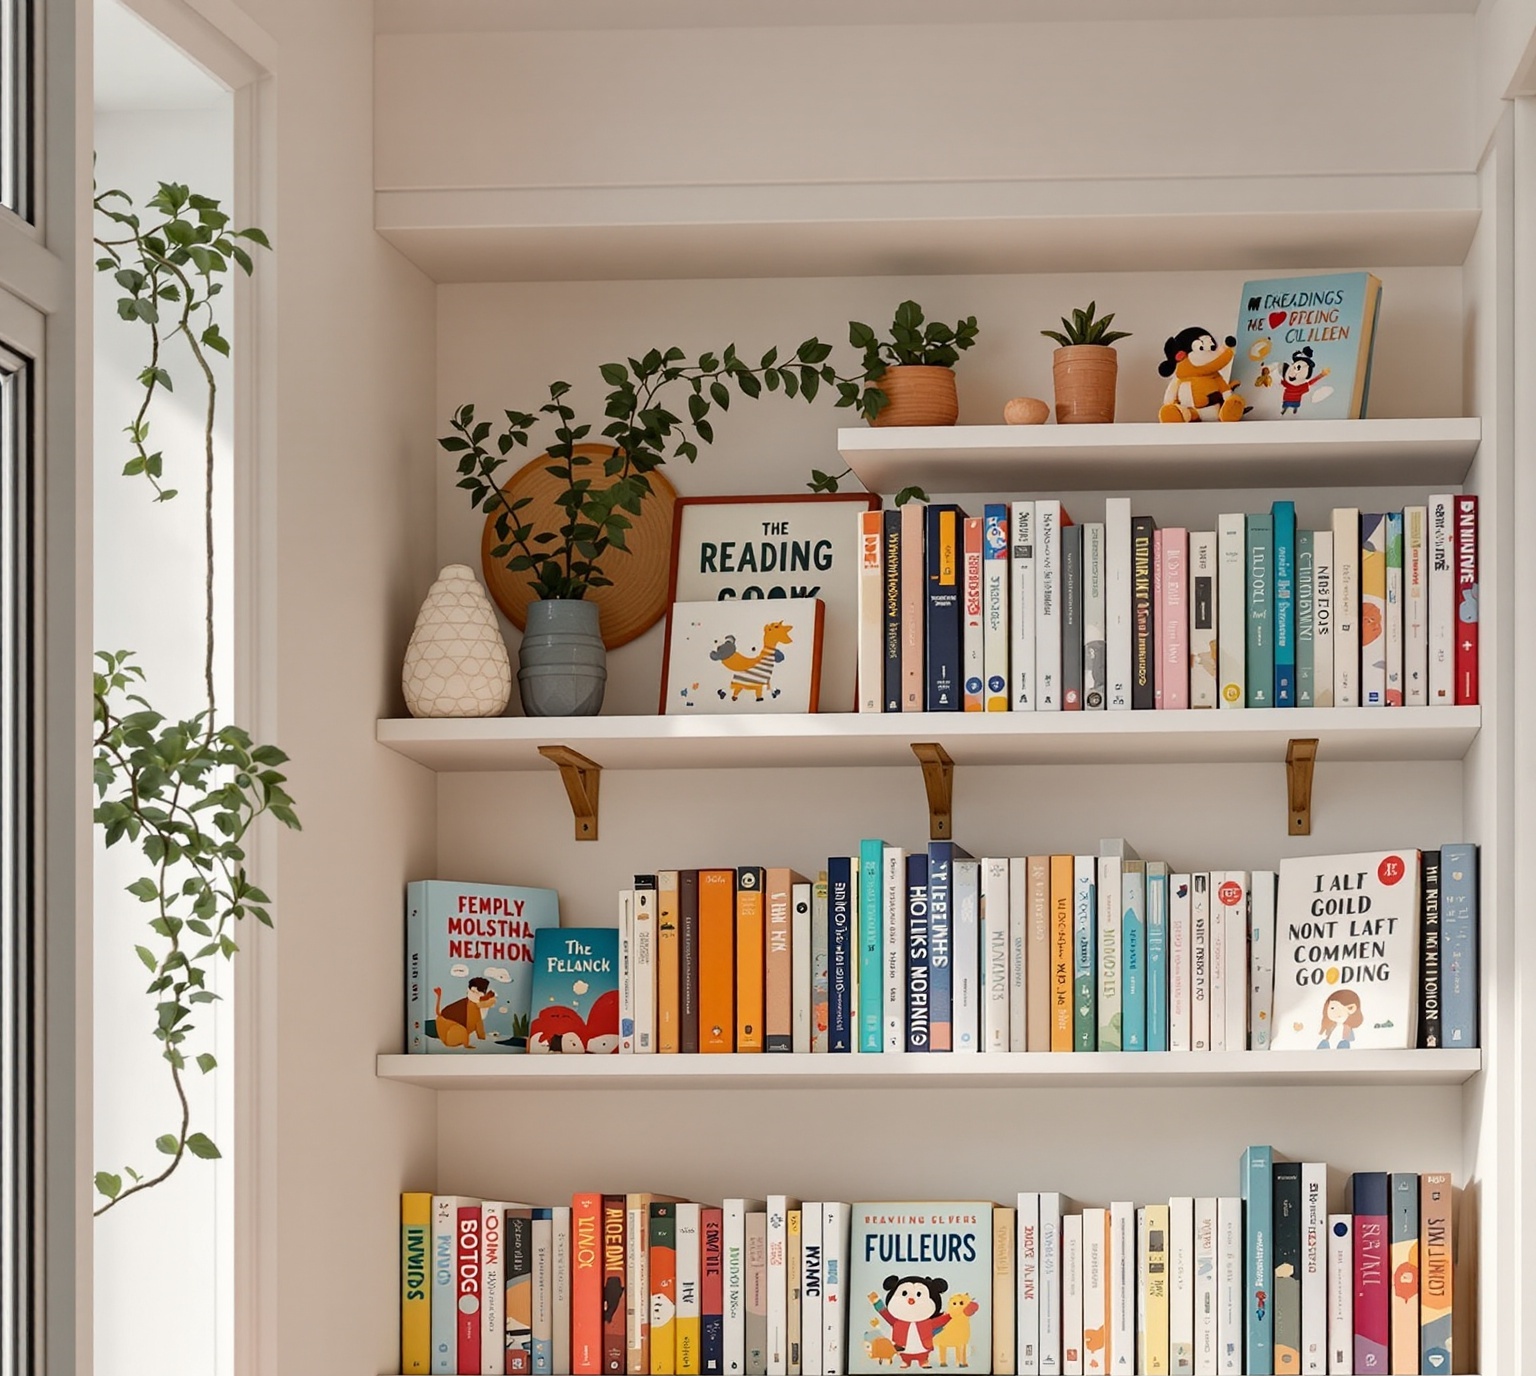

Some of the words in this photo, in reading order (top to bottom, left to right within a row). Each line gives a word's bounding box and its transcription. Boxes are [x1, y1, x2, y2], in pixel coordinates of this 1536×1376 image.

[762, 522, 790, 536] THE
[700, 540, 834, 573] READING
[458, 895, 525, 917] FEMPLY
[1311, 895, 1372, 917] GOILD
[1288, 921, 1339, 941] NONT
[1350, 917, 1399, 937] LAFT
[565, 940, 593, 956] The
[1293, 941, 1386, 964] COMMEN
[865, 1234, 976, 1262] FULLEURS
